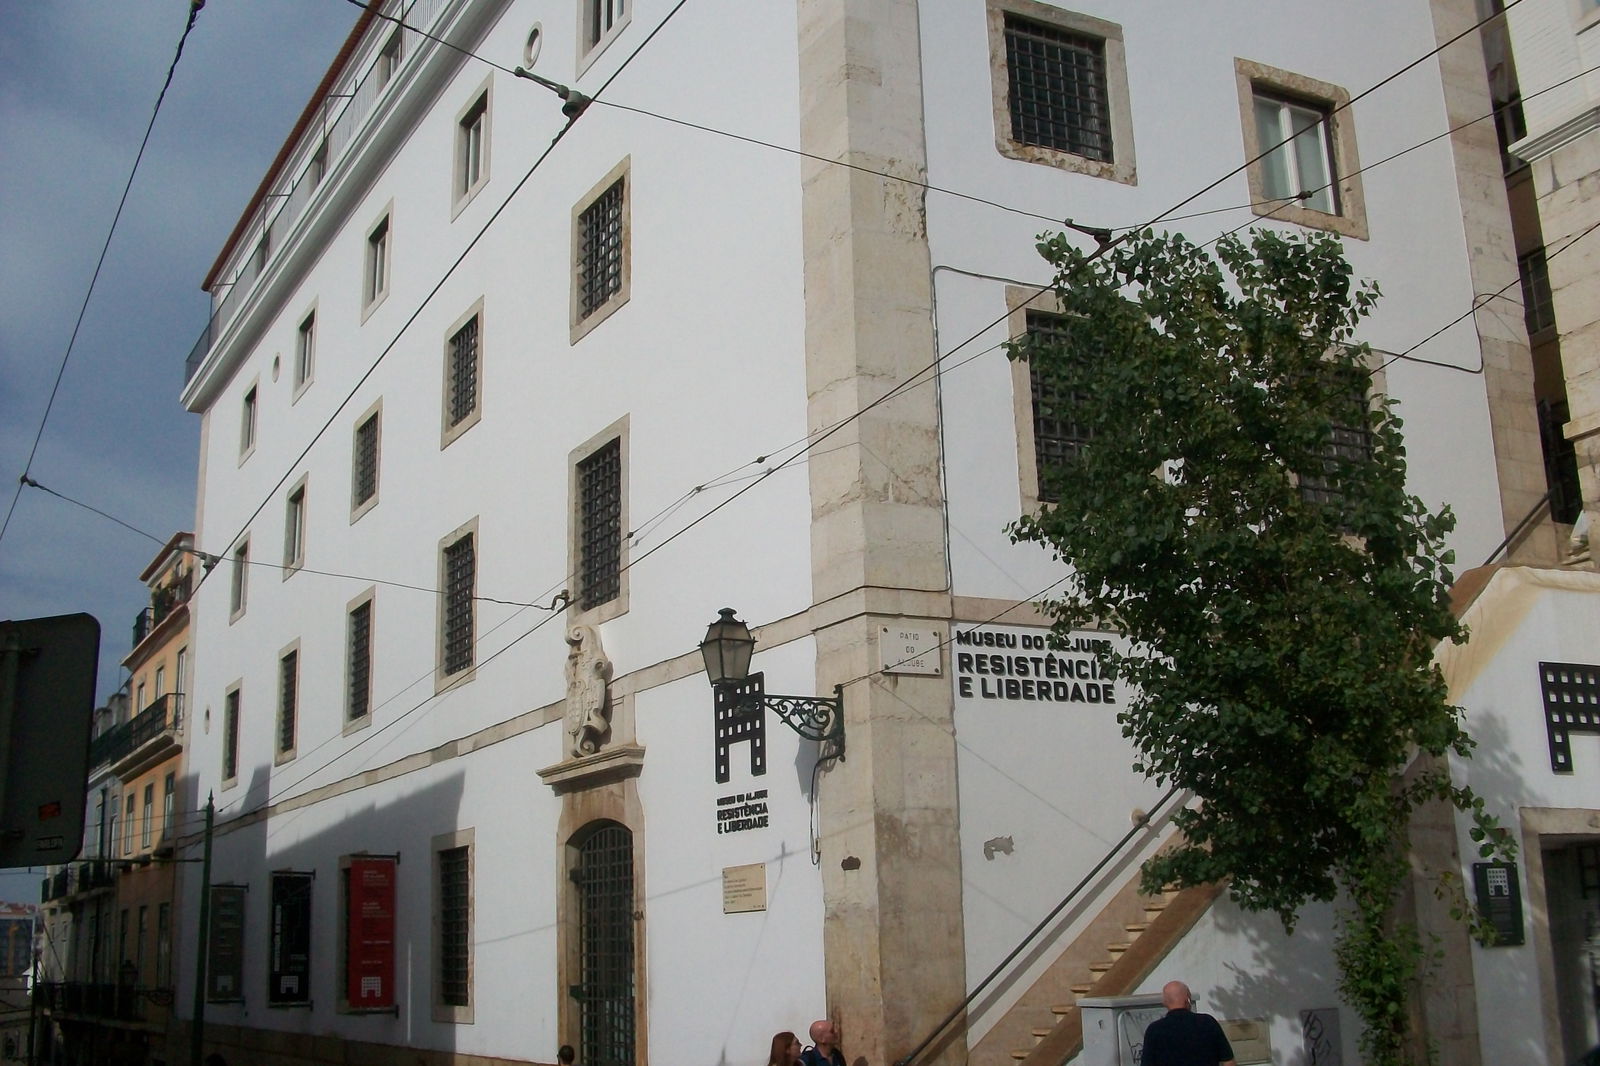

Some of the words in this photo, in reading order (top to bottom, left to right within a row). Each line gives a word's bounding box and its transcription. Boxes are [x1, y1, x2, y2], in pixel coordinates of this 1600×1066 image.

[956, 630, 1017, 649] MUSEU
[1021, 634, 1045, 650] DO
[897, 658, 925, 668] LUBE
[958, 676, 974, 698] E
[980, 677, 1116, 704] LIBERDADE
[718, 823, 723, 834] E
